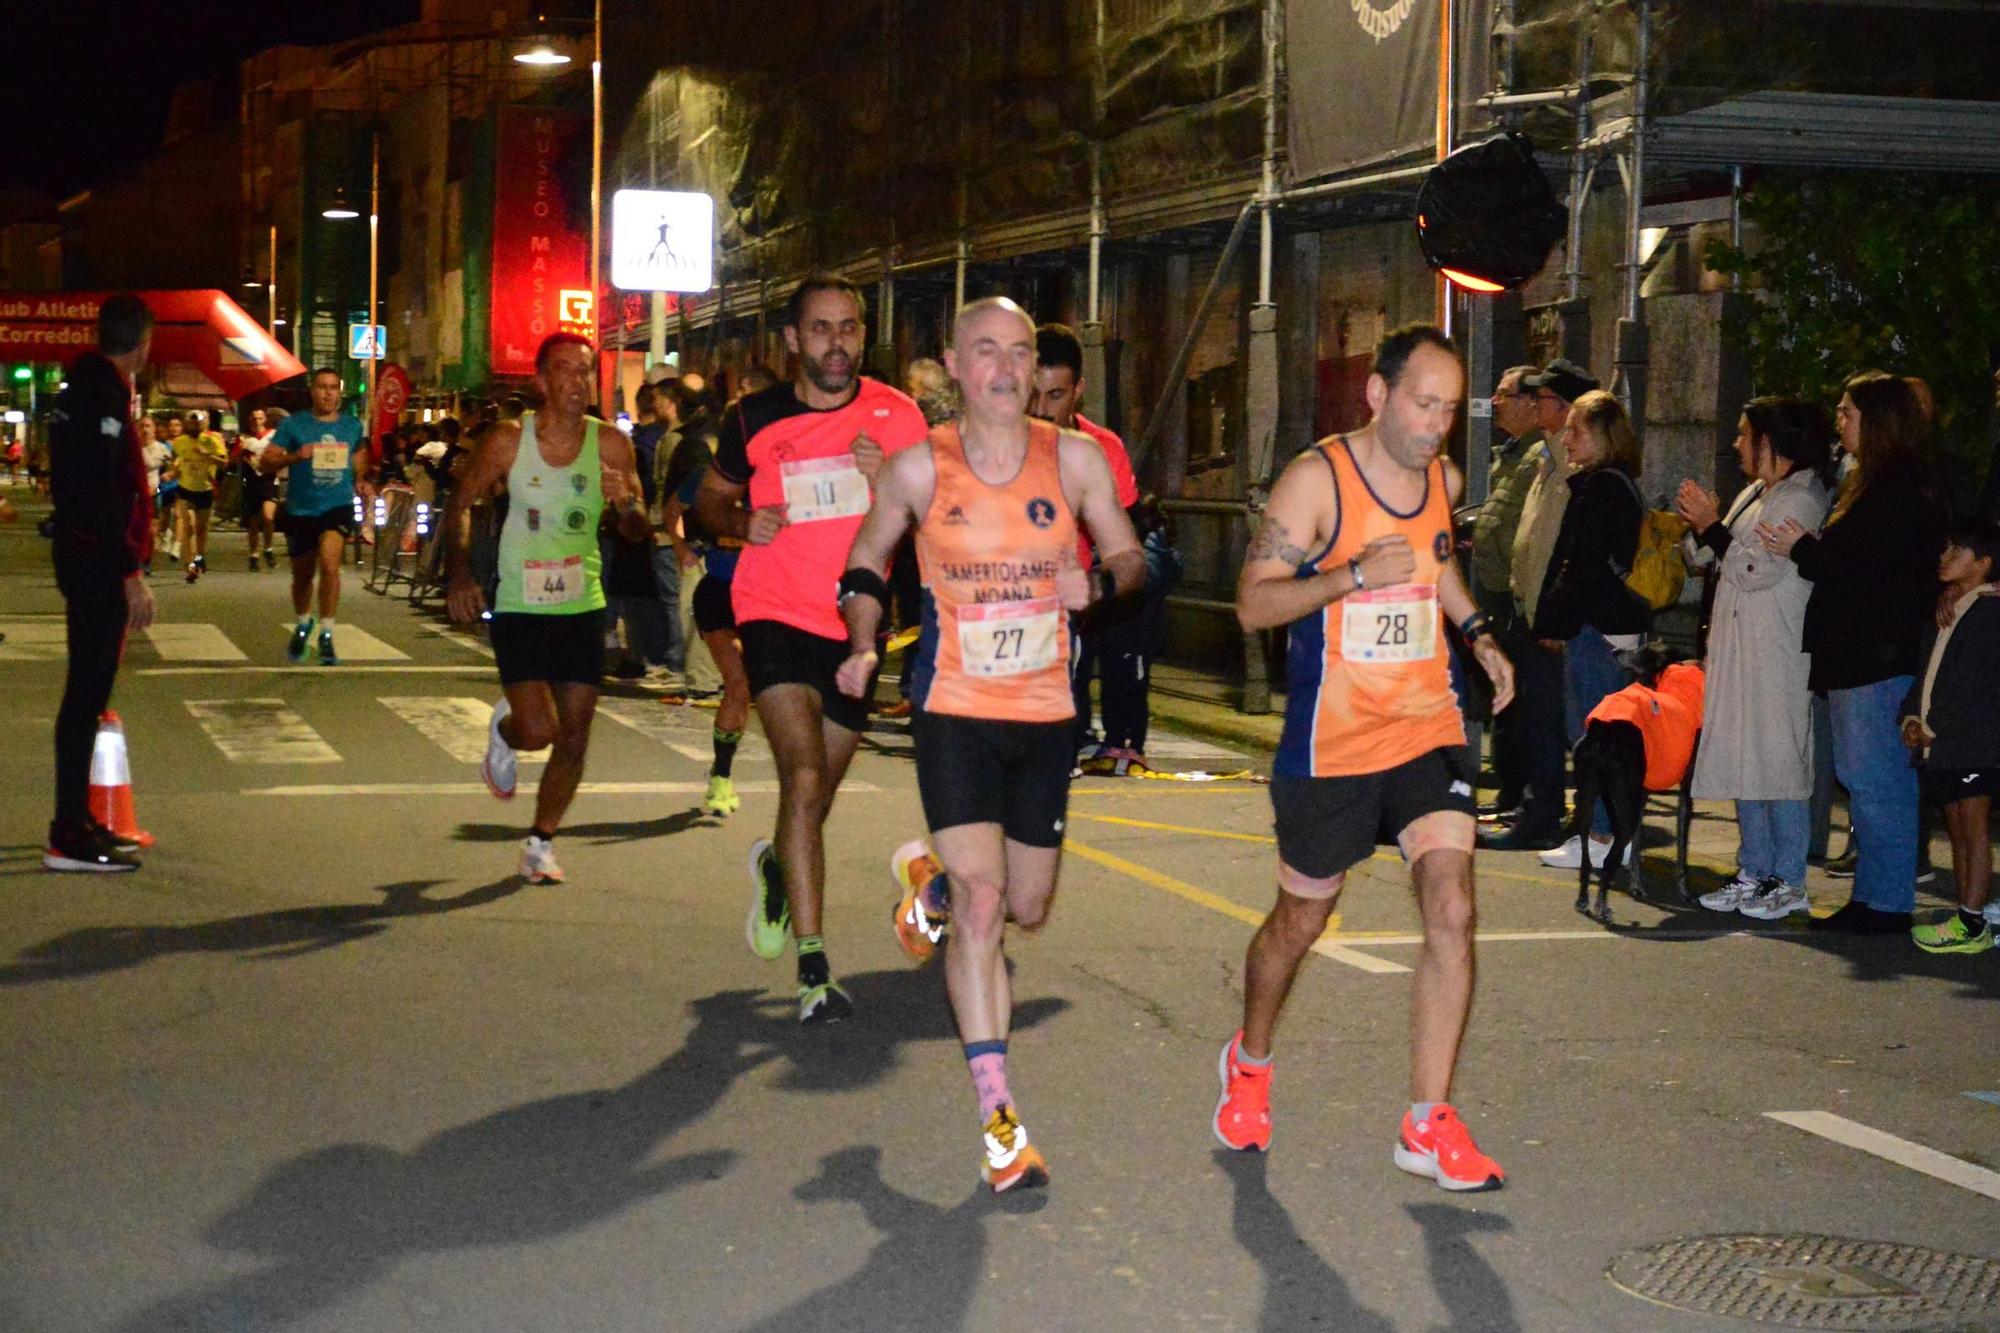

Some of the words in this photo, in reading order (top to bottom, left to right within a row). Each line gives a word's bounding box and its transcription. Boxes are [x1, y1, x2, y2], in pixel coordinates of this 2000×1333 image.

[544, 575, 566, 593] 44
[992, 628, 1025, 660] 27
[1376, 614, 1408, 646] 28
